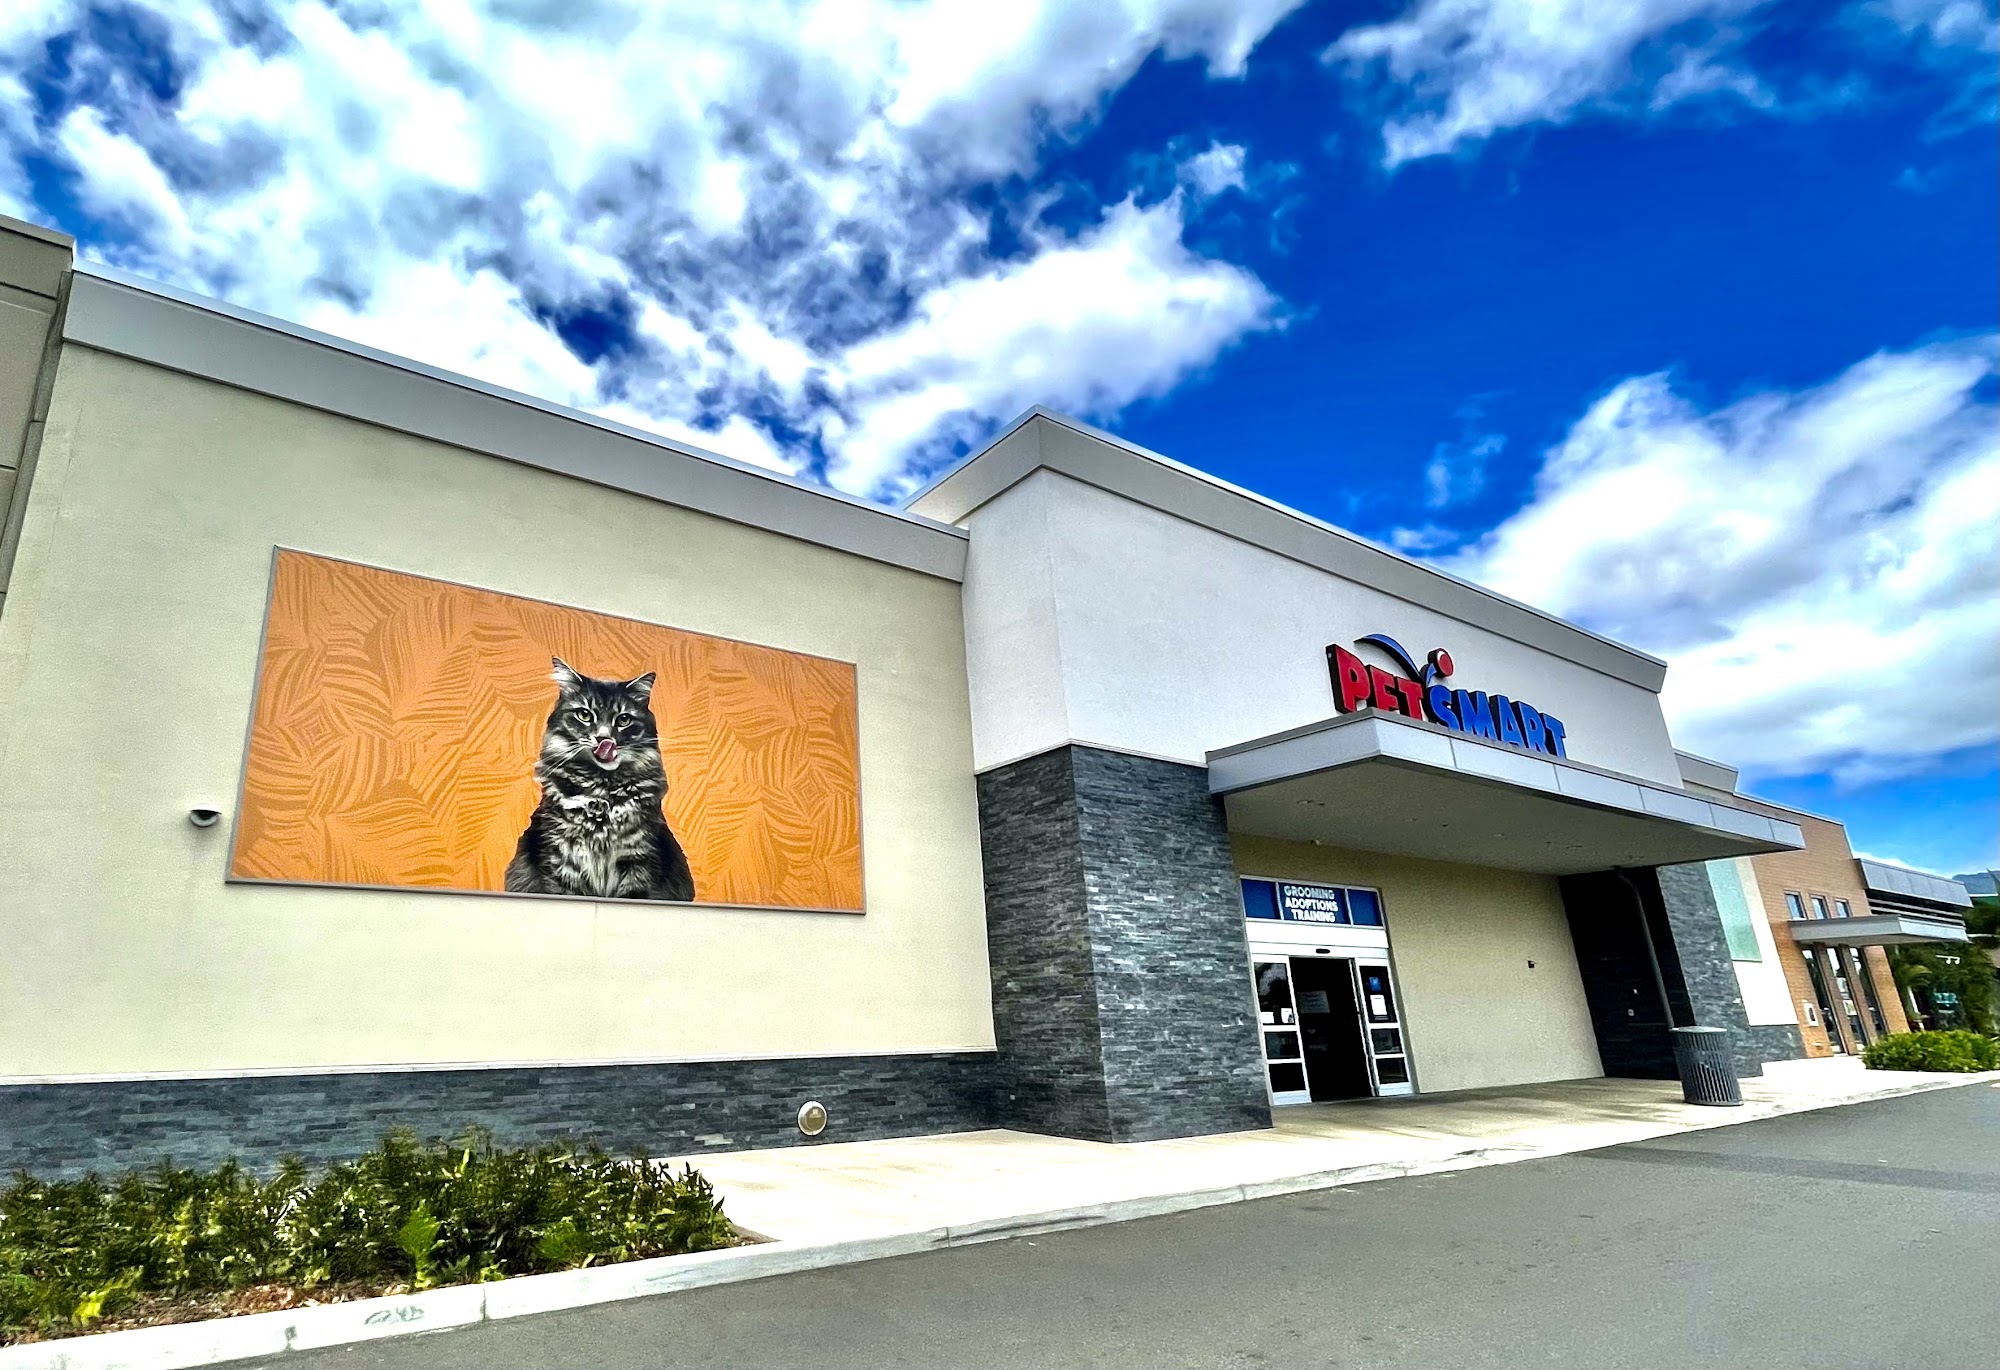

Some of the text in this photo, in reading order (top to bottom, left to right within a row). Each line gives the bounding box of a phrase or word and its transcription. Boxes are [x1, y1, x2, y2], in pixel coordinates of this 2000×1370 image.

[1283, 885, 1335, 899] GROOMING
[1284, 897, 1338, 912] ADOPTIONS
[1291, 908, 1336, 923] TRAINING
